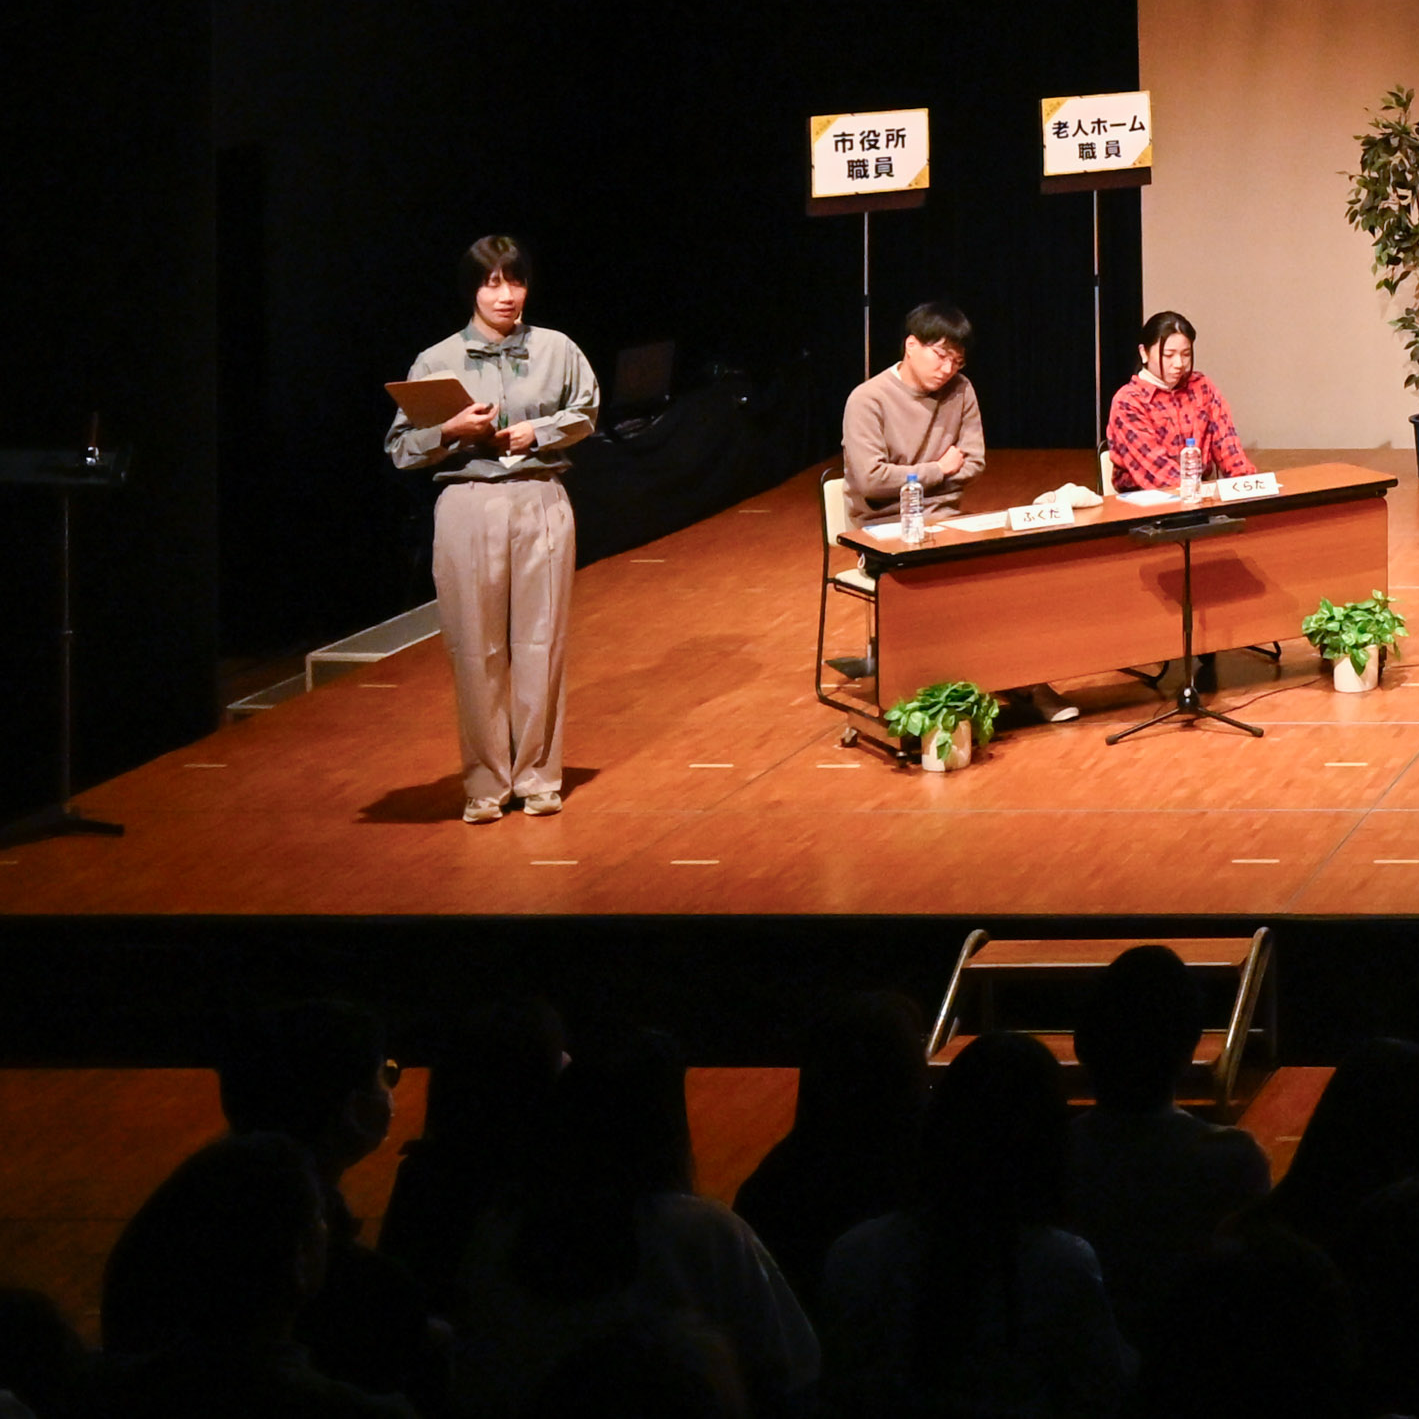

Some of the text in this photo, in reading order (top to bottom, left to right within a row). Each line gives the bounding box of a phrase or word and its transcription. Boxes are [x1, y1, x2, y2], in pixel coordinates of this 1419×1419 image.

[1051, 114, 1146, 139] 老人ホーム
[833, 127, 907, 154] 市役所
[1078, 140, 1122, 161] 職員
[846, 156, 895, 181] 職員
[1232, 480, 1266, 492] くらた
[1023, 509, 1061, 522] ふくだ
